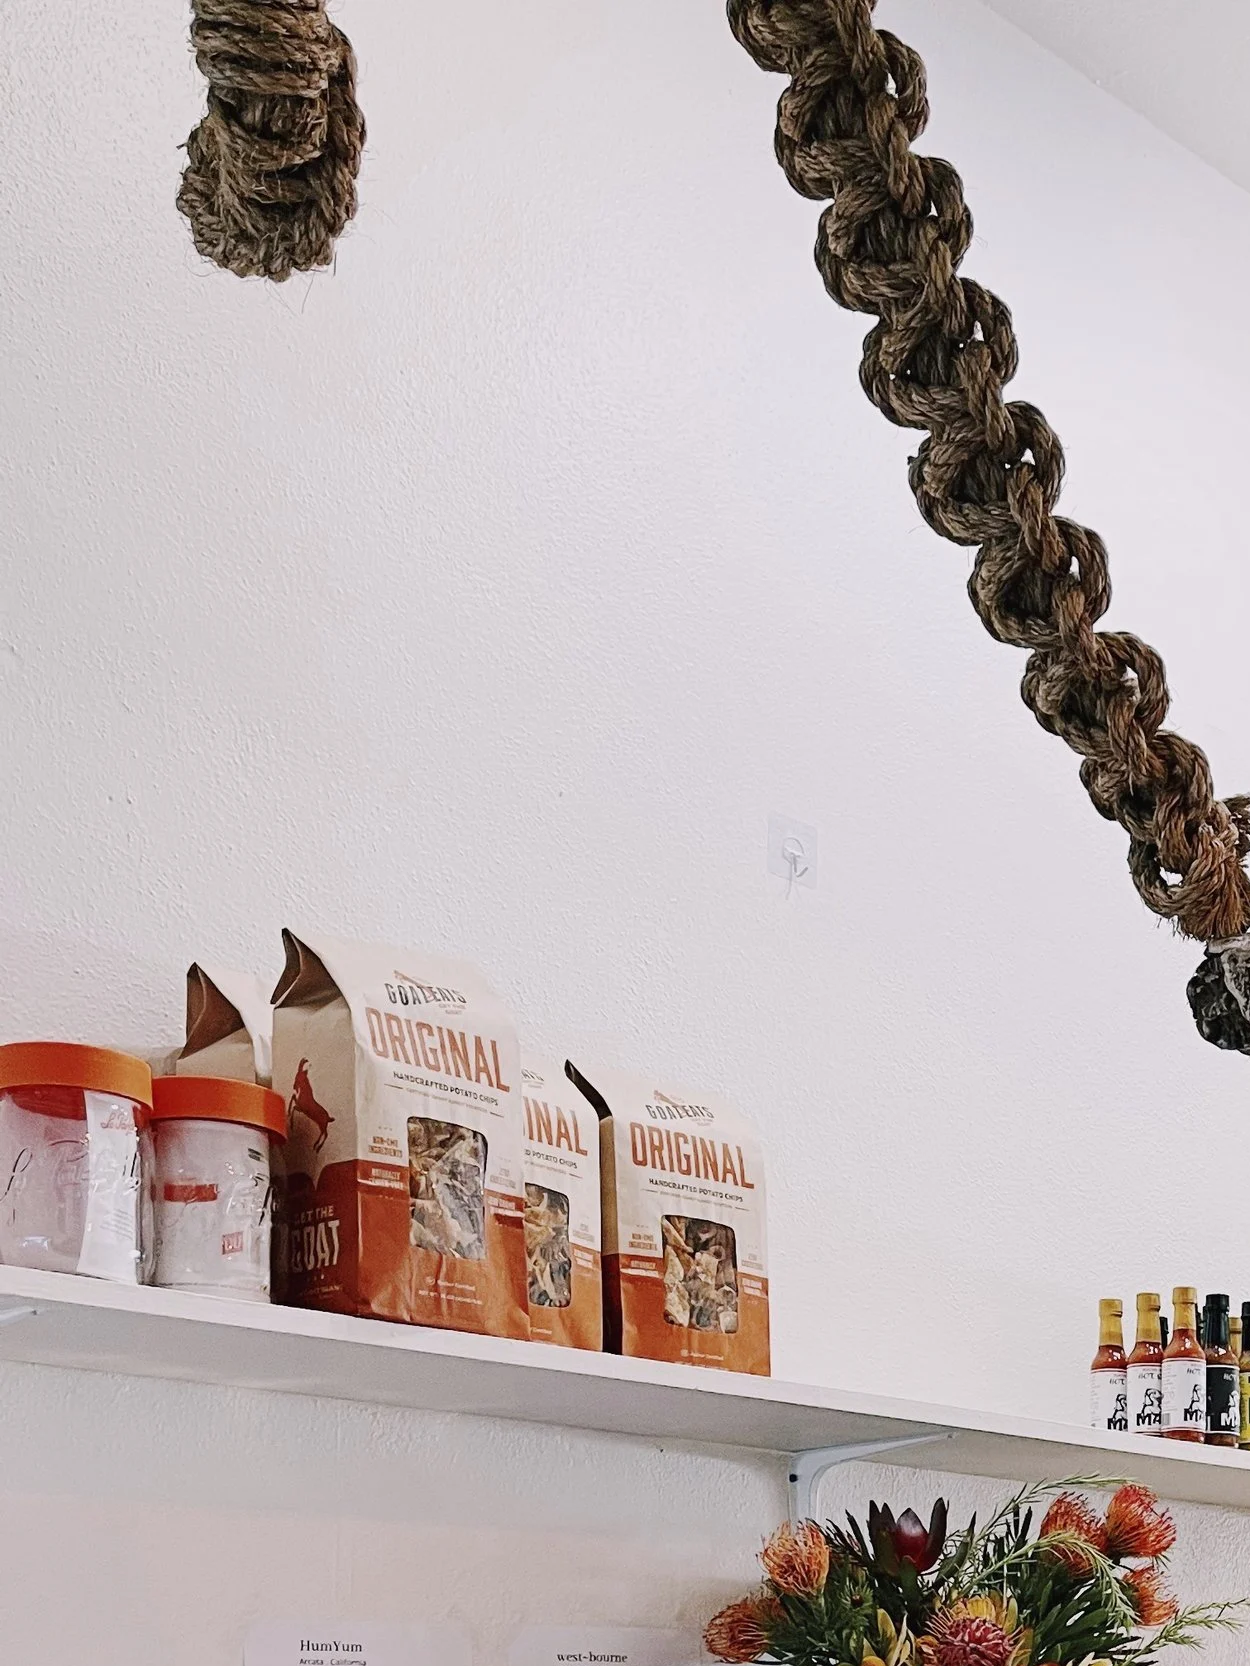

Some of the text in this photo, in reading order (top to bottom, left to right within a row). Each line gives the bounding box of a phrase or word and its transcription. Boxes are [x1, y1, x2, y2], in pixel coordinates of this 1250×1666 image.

[365, 1006, 511, 1093] ORIGINAL
[392, 1070, 454, 1093] HANDCRAFTED
[449, 1085, 478, 1100] POTATO
[478, 1093, 499, 1106] CHIPS
[629, 1120, 755, 1189] ORIGINAL
[300, 1640, 362, 1652] HumYum
[330, 1658, 366, 1666] California
